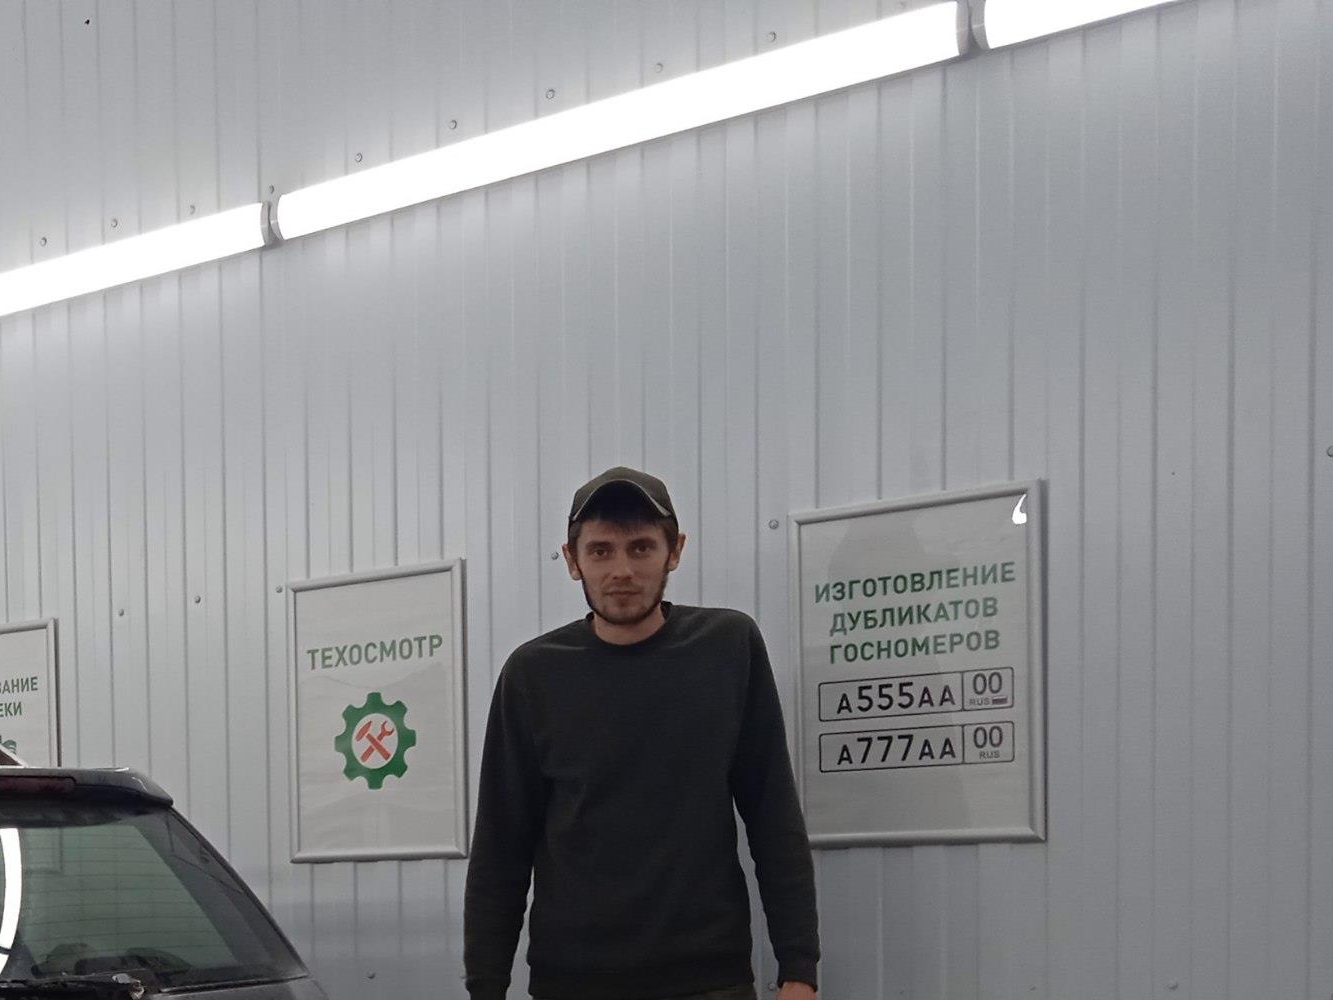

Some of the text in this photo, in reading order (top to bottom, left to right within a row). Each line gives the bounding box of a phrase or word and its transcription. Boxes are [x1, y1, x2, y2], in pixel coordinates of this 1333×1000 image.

[814, 561, 1016, 603] ИЗГОТОВЛЕНИЕ
[829, 597, 999, 637] ДУБЛИКАТОВ
[307, 634, 443, 670] ТЕХОСМОТР
[830, 629, 1001, 664] ГОСНОМЕРОВ
[837, 671, 1003, 714] А555АА 00
[969, 697, 990, 706] RUS
[837, 725, 1004, 765] А777АА 00
[979, 750, 1001, 759] RUS
